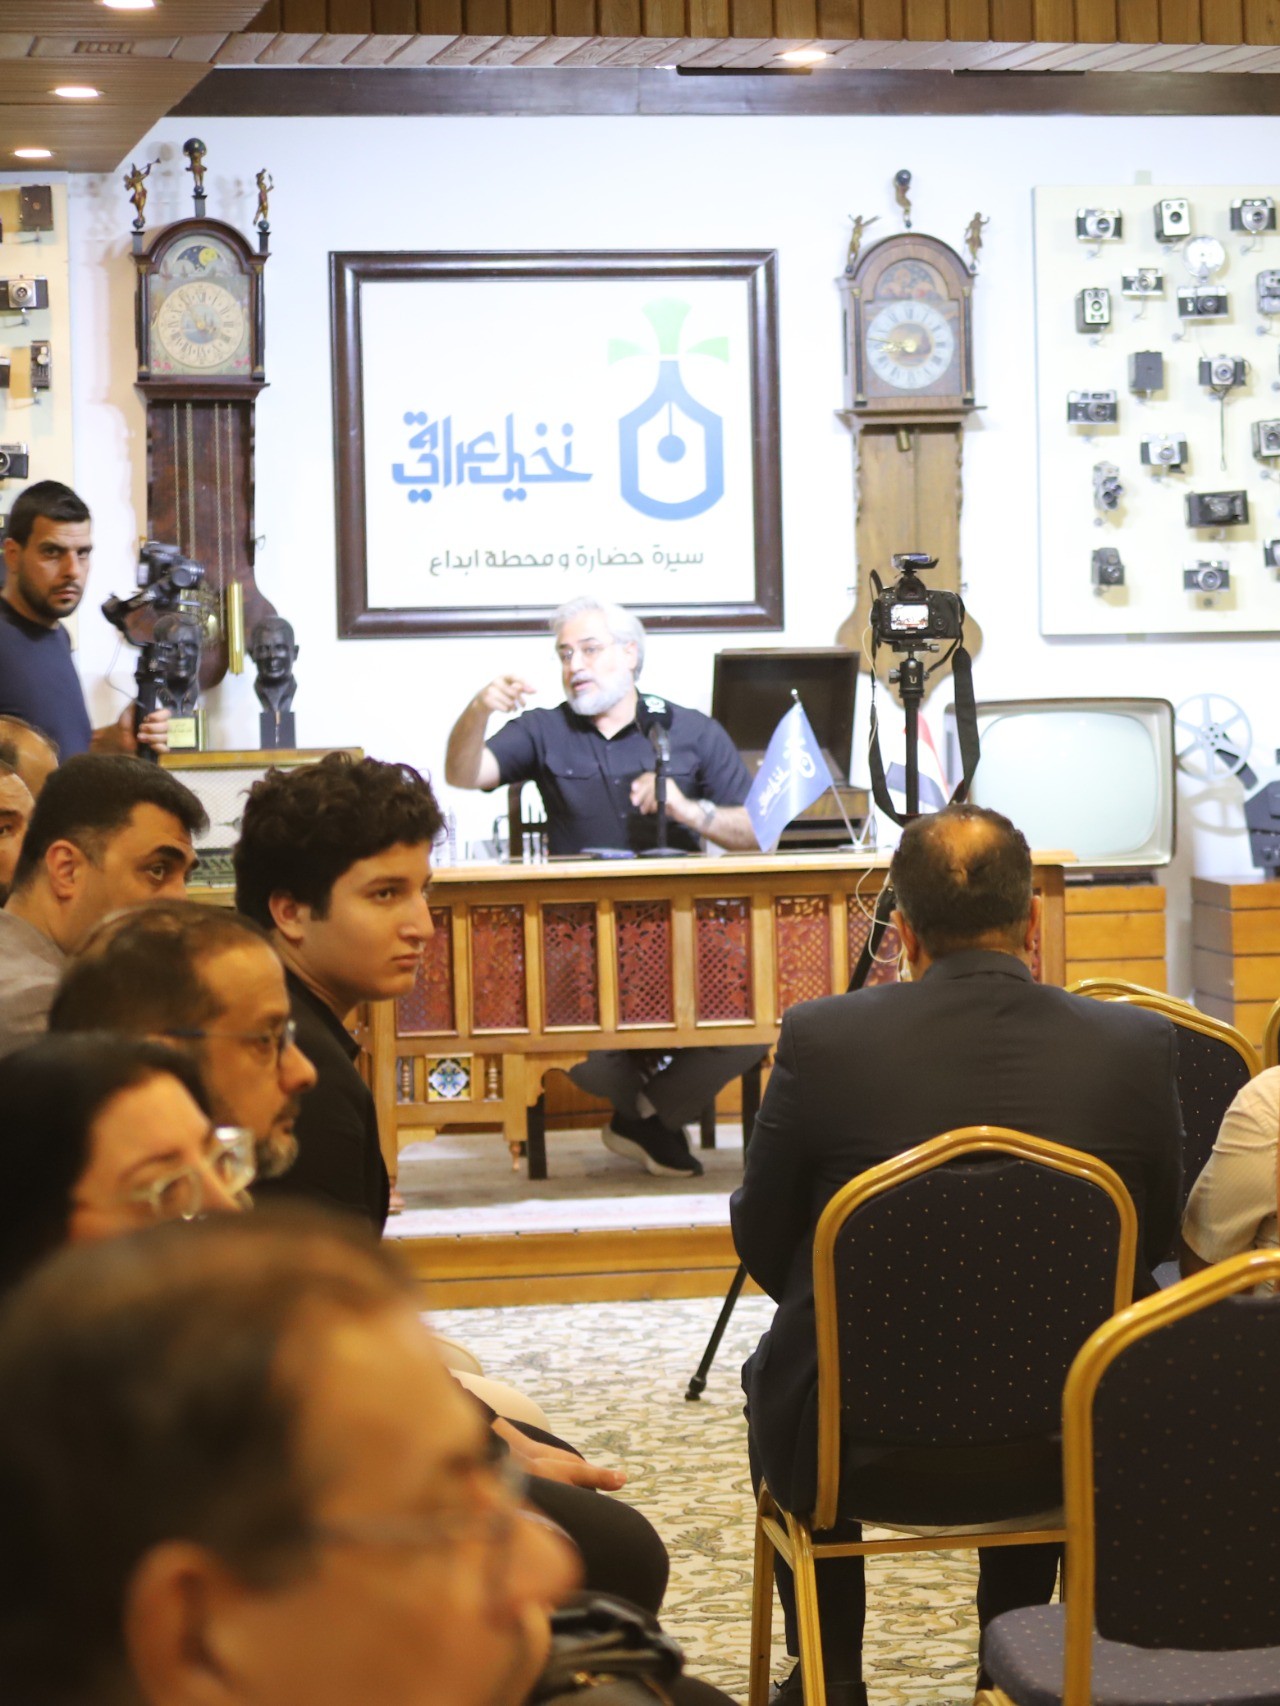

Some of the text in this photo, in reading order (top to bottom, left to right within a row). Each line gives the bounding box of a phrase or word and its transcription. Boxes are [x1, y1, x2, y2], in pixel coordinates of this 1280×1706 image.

[391, 411, 593, 503] نخيل عراقي
[429, 549, 479, 576] ابداع
[576, 545, 644, 573] حضارة
[652, 544, 704, 573] سيرة
